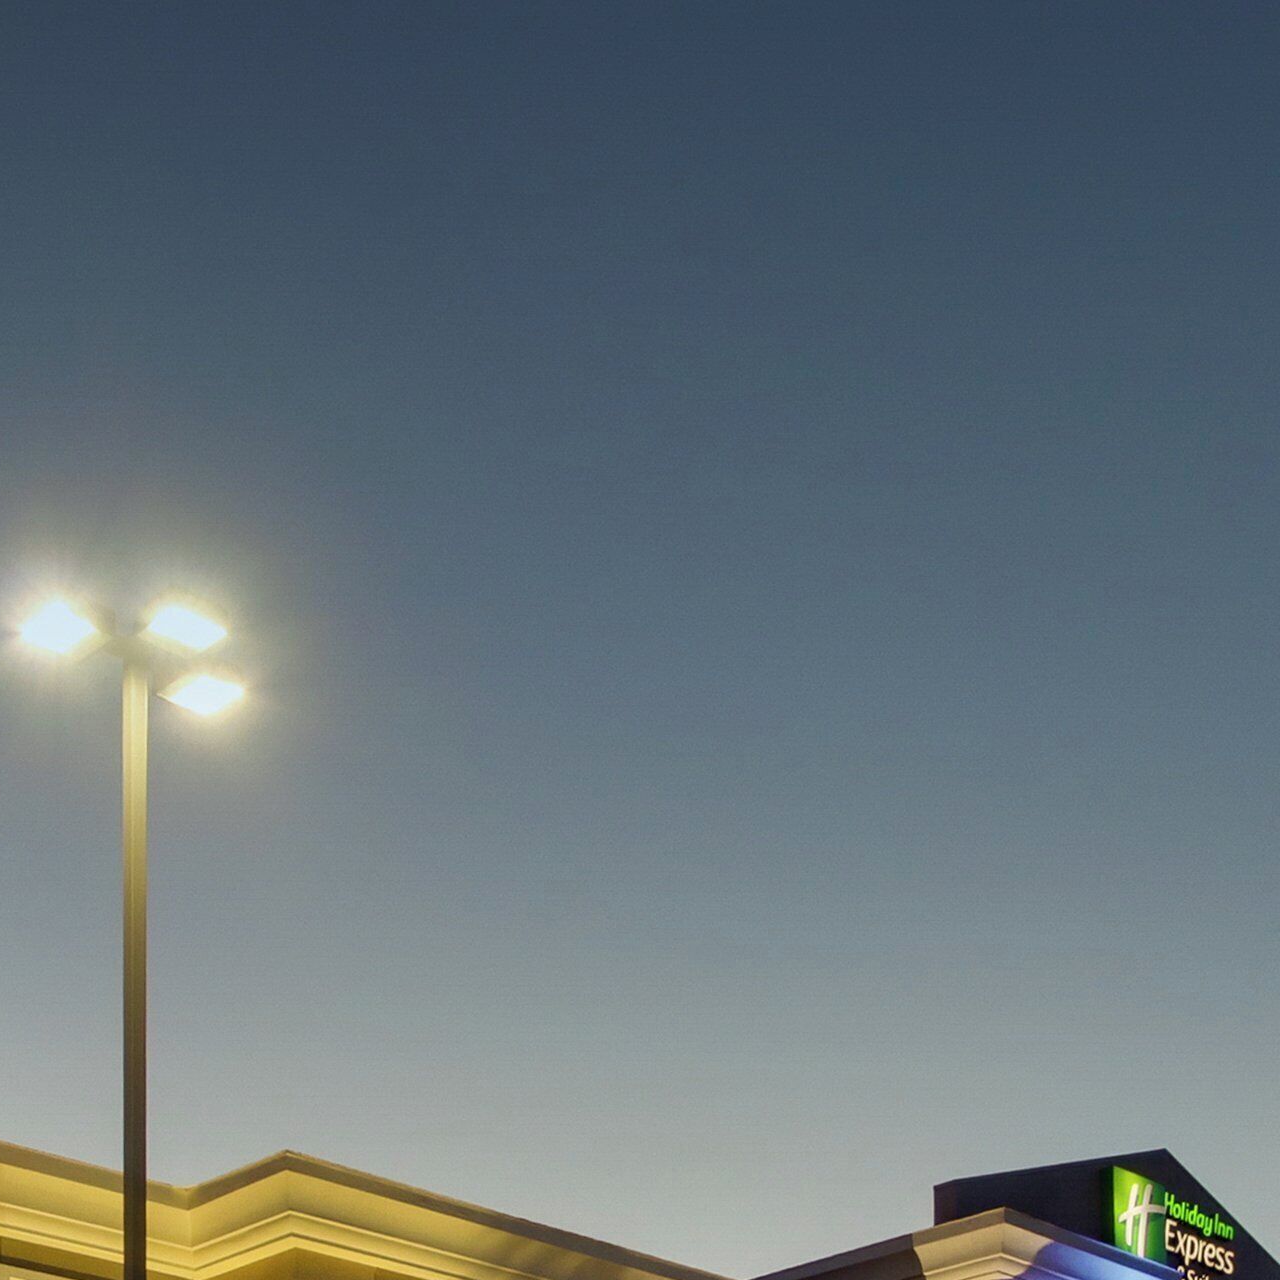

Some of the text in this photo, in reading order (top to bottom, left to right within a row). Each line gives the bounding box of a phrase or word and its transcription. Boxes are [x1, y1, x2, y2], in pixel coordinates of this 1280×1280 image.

[1164, 1191, 1234, 1240] Holiday Inn
[1165, 1219, 1235, 1274] Express
